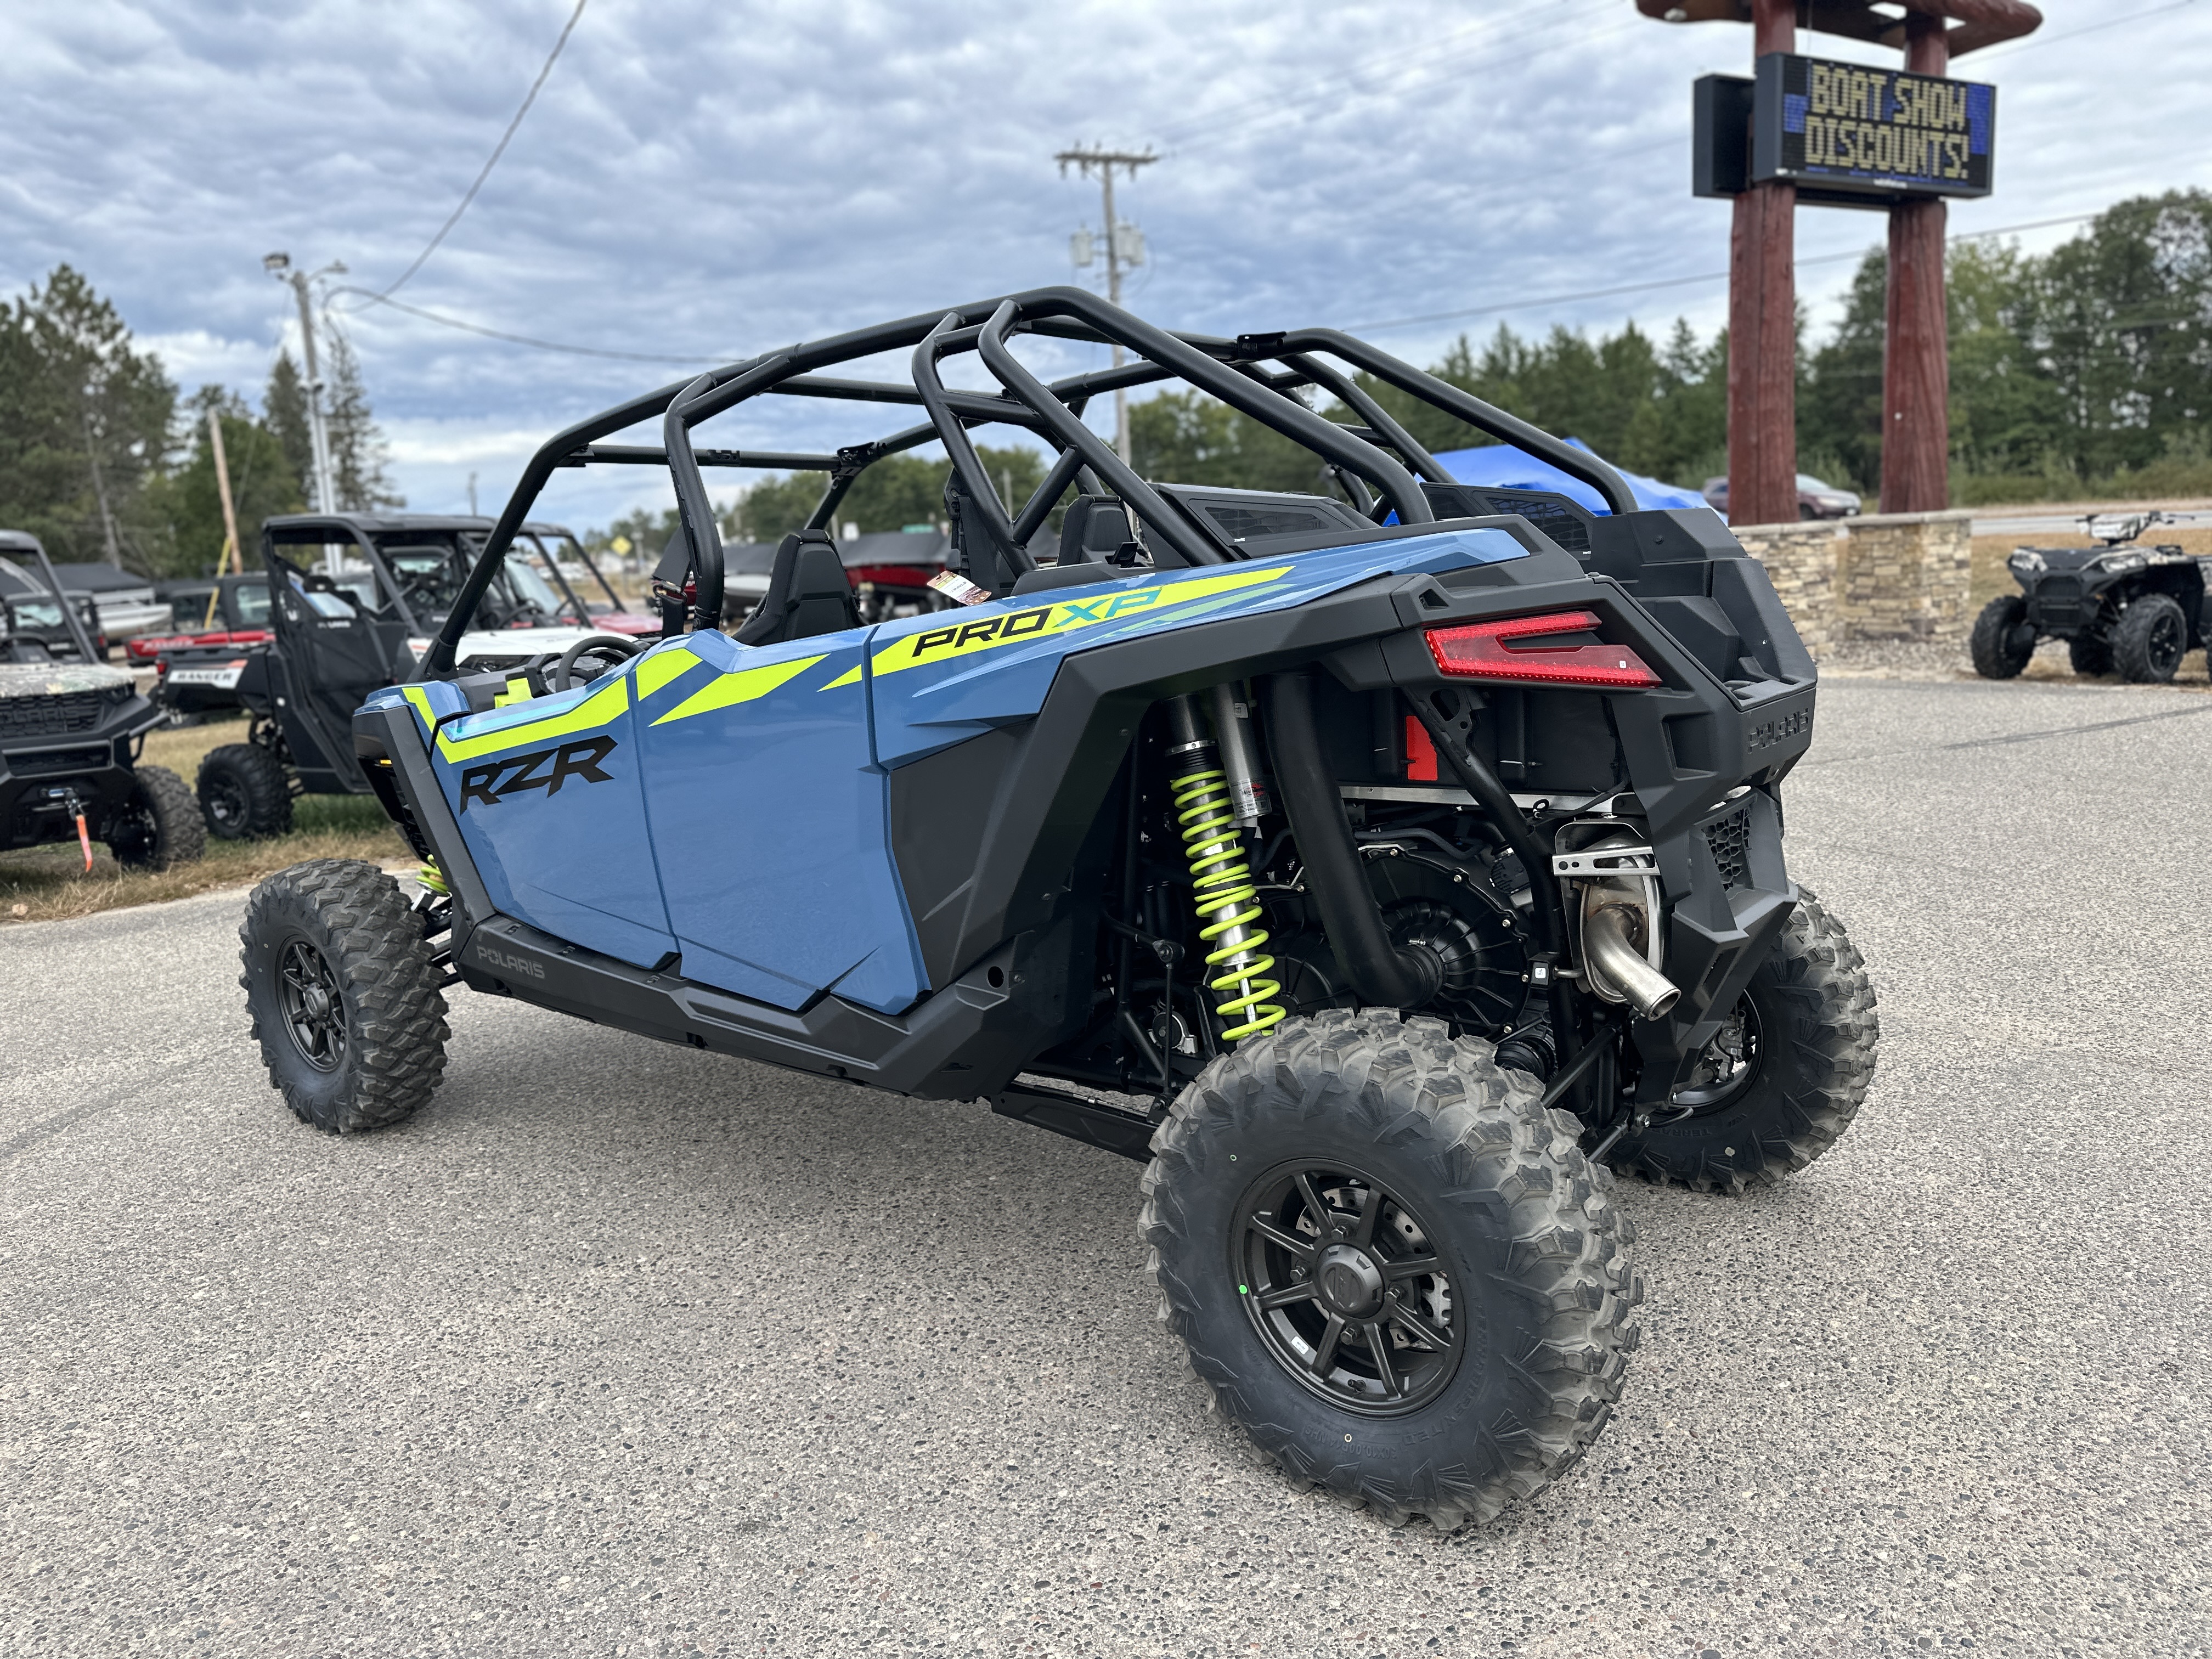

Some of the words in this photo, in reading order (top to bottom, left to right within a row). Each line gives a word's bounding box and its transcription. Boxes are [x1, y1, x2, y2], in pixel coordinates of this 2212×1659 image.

[1812, 65, 1887, 121] BOAT
[1894, 78, 1967, 131] SHOW
[1805, 116, 1969, 179] DISCOUNTS!
[911, 607, 1053, 658] PRO
[1051, 589, 1162, 628] XP
[177, 672, 233, 680] RANGER
[1747, 707, 1809, 754] POLARIS
[459, 734, 618, 816] RZR
[476, 945, 545, 979] POLARIS
